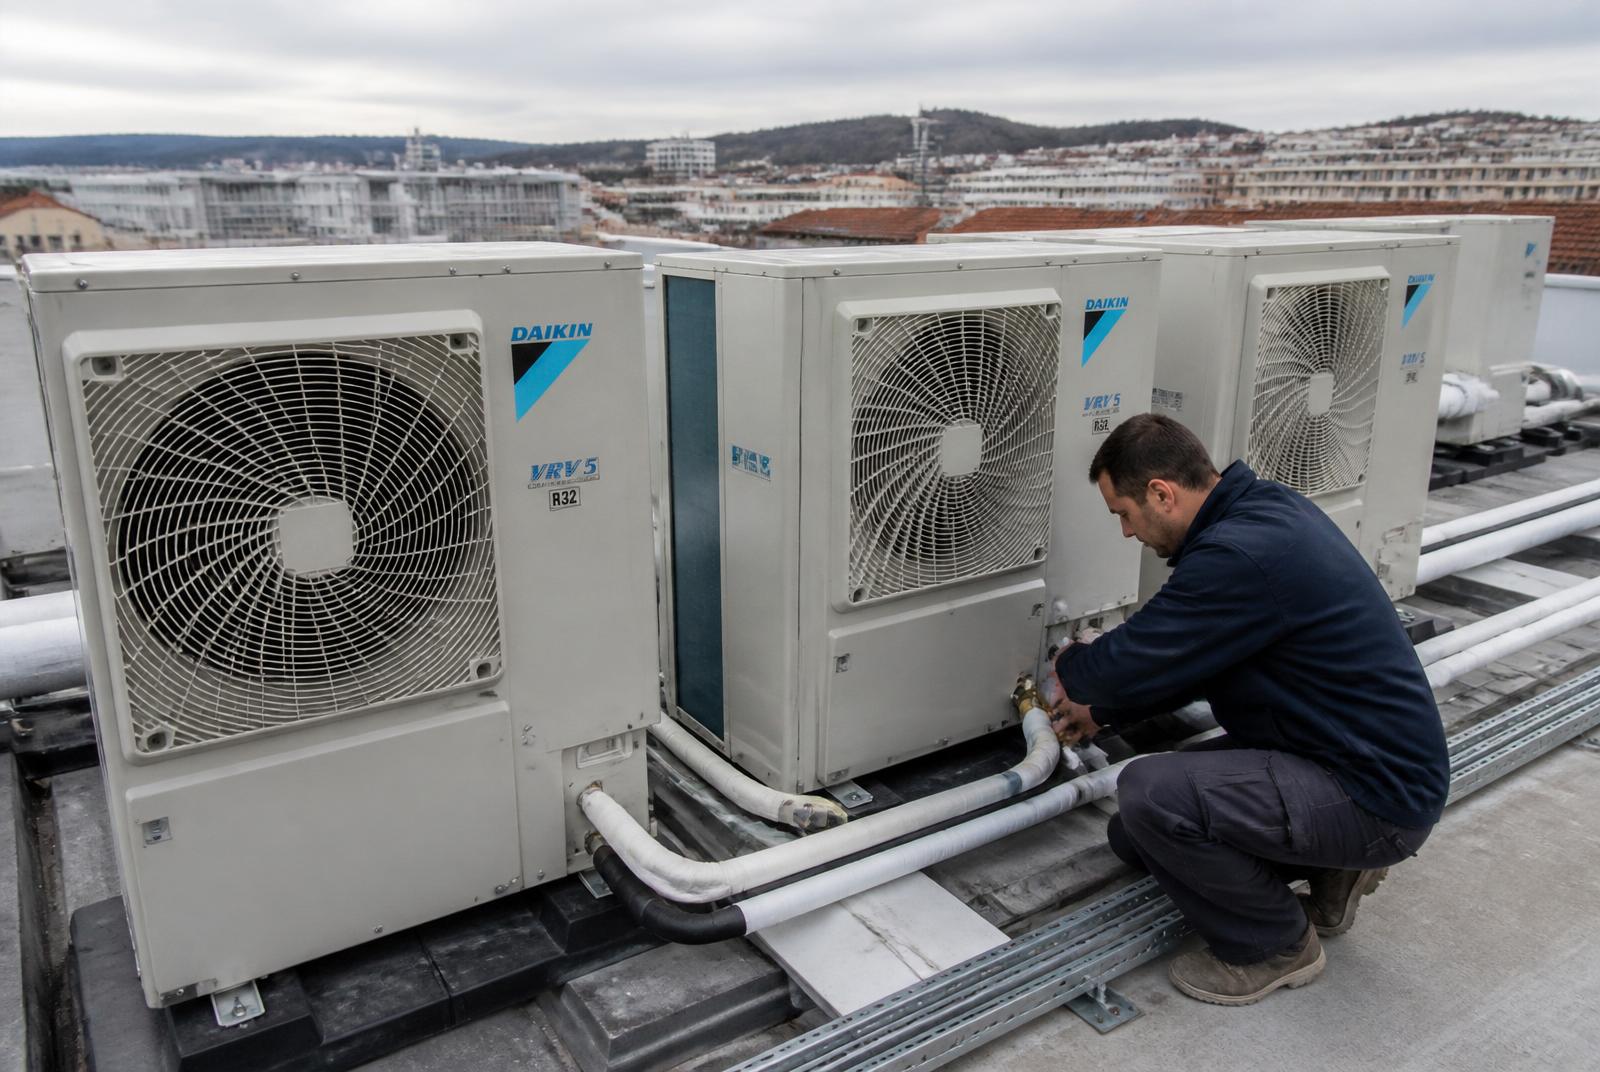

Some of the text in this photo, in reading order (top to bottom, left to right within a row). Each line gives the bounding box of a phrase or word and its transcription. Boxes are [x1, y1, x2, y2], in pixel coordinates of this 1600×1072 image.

[1086, 297, 1129, 310] DAIKIN
[511, 323, 593, 341] DAIKIN
[531, 457, 598, 480] VRV 5
[552, 490, 578, 506] R32
